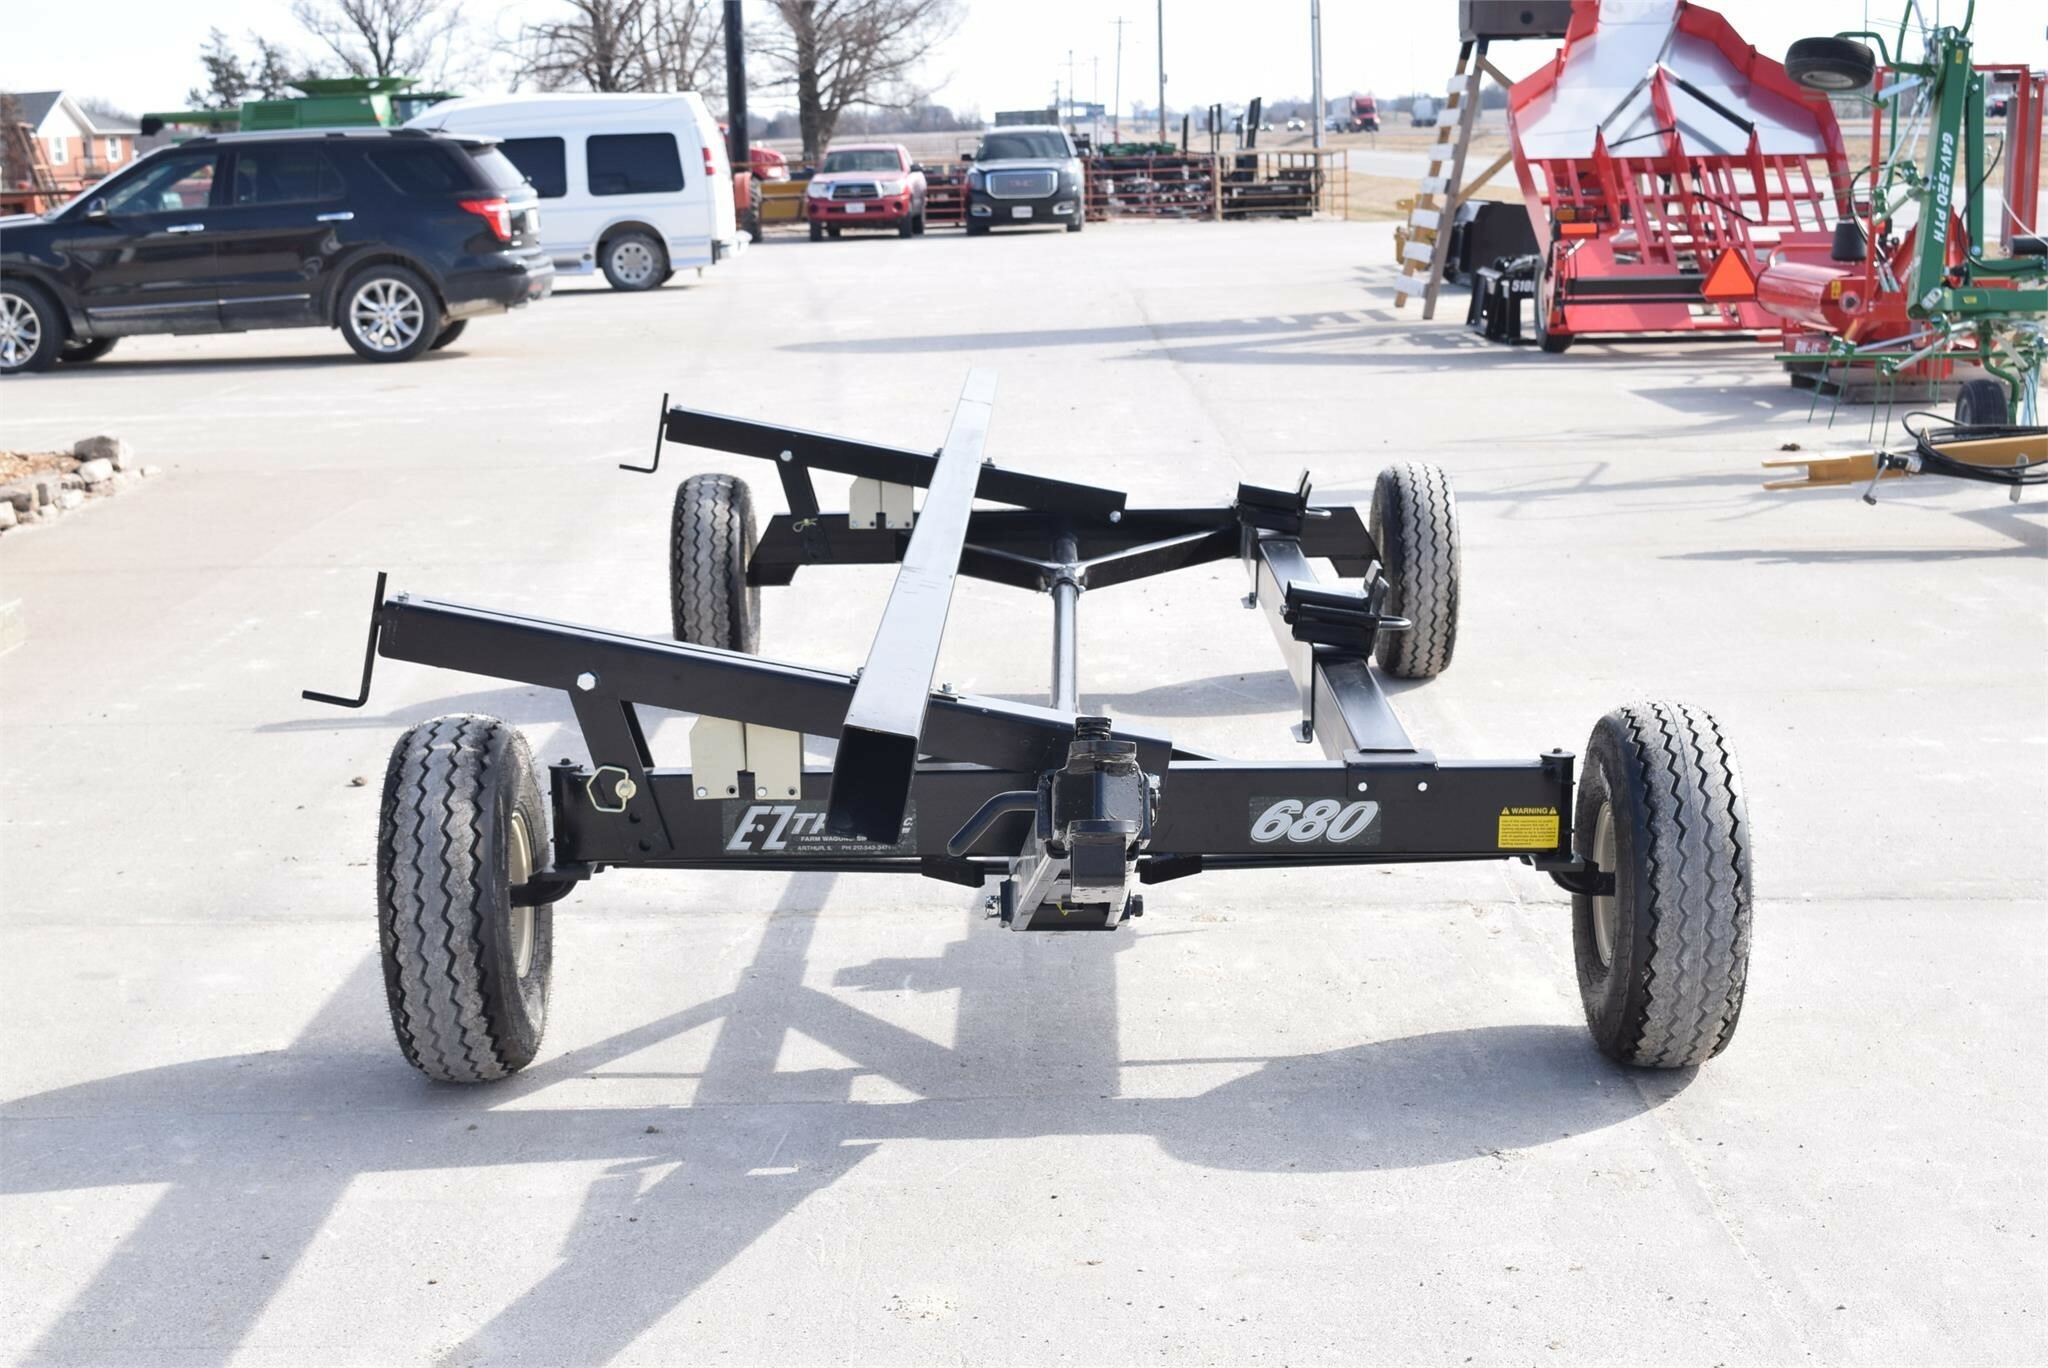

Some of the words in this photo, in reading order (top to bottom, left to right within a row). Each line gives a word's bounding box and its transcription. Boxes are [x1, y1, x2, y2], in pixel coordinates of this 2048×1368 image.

[1936, 132, 1953, 206] G4V-520
[1933, 208, 1947, 243] PTH
[1250, 799, 1379, 843] 680
[1511, 807, 1548, 815] WARNING
